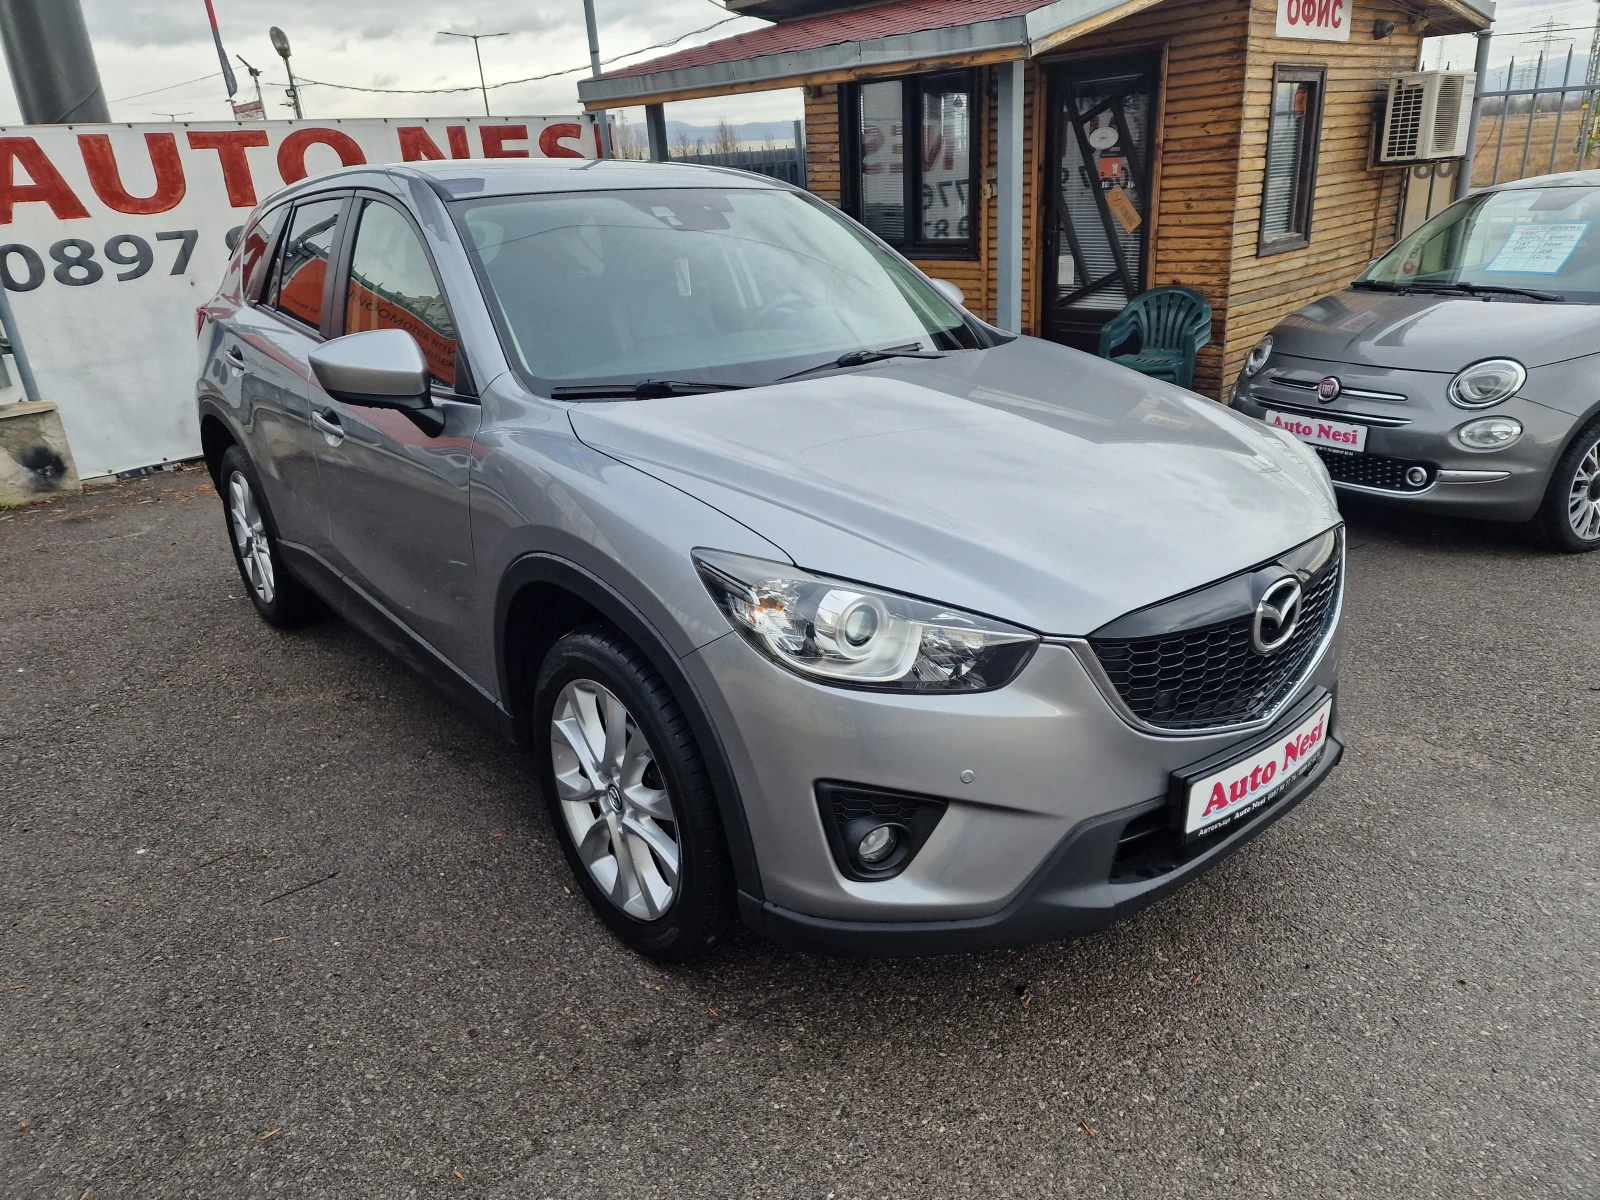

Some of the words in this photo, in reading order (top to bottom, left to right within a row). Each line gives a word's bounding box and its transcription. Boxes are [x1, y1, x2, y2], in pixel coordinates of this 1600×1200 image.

[1287, 0, 1343, 28] ОФИС
[0, 127, 367, 225] AUTO
[397, 122, 612, 161] NES
[0, 229, 199, 292] 0897
[1273, 416, 1312, 436] Auto
[1317, 424, 1358, 444] Nesi
[1202, 761, 1277, 818] Auto
[1282, 712, 1325, 772] Nesi
[1233, 807, 1251, 820] Auto
